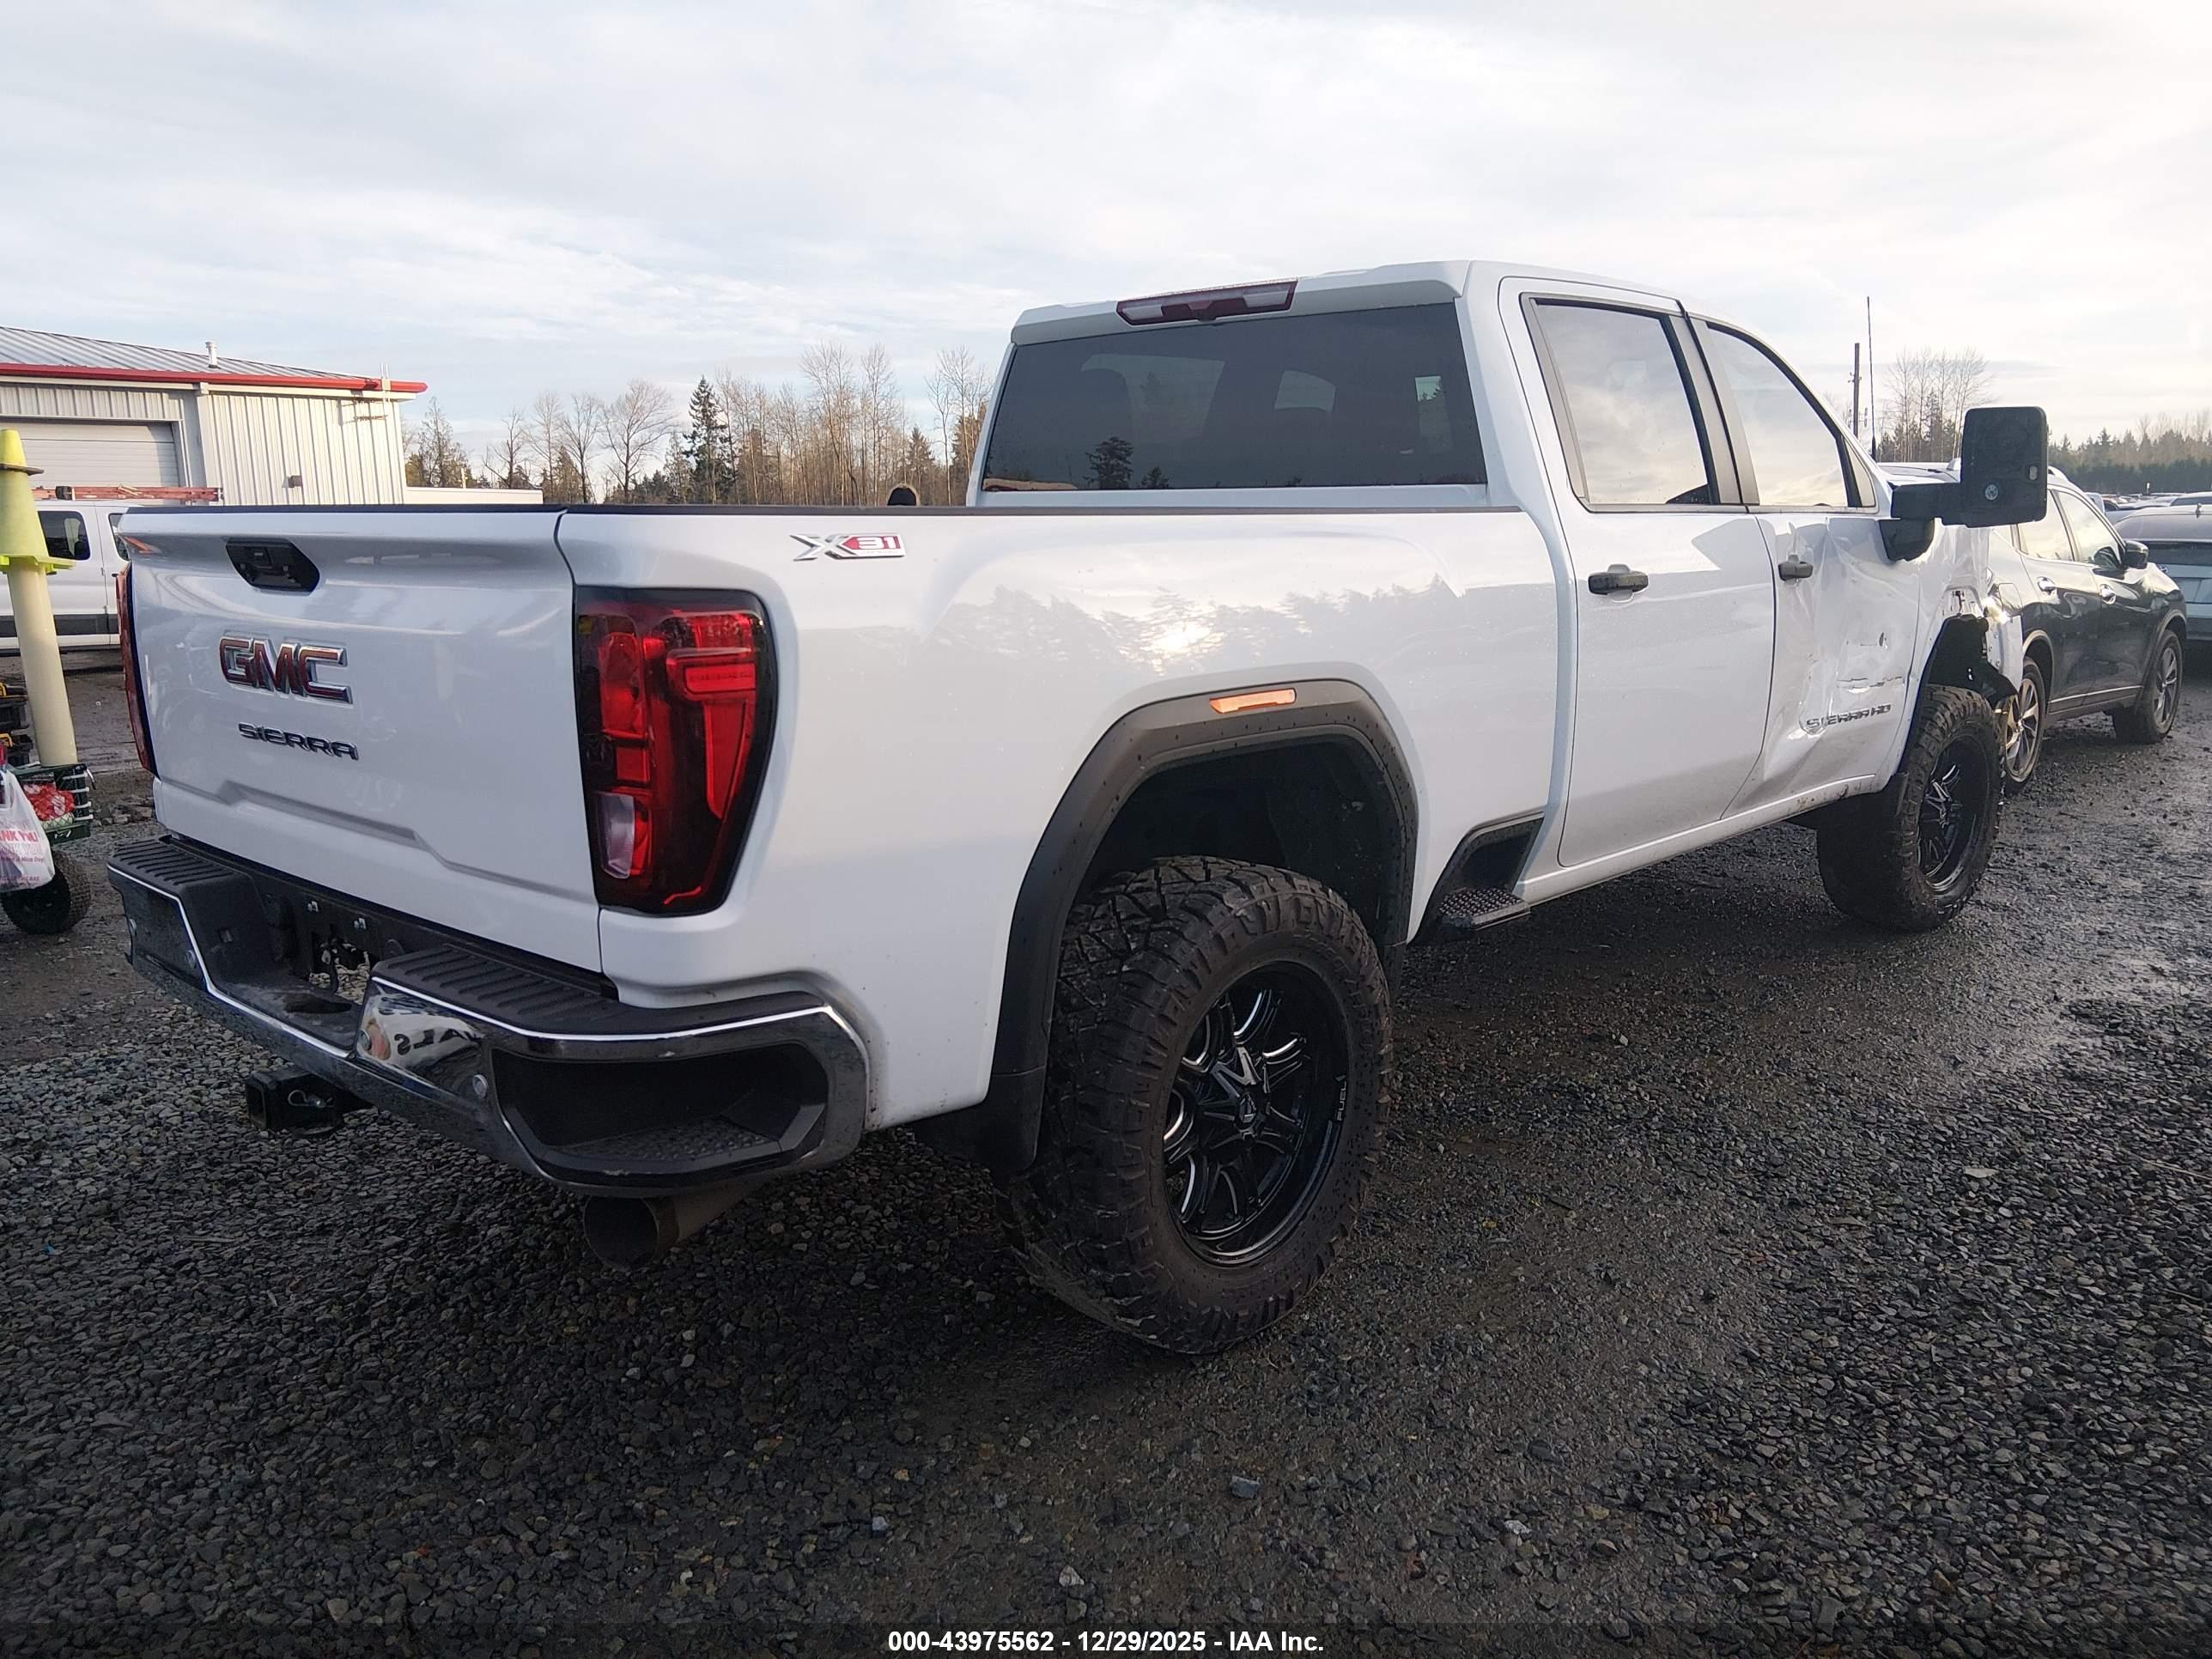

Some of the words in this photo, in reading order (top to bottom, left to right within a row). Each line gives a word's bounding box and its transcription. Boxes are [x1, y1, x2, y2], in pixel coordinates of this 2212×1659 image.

[219, 635, 353, 705] GMC
[1805, 708, 1870, 728] SIERRA
[1871, 702, 1892, 717] HD
[238, 721, 360, 761] SIERRA
[1337, 1080, 1347, 1121] FUEL
